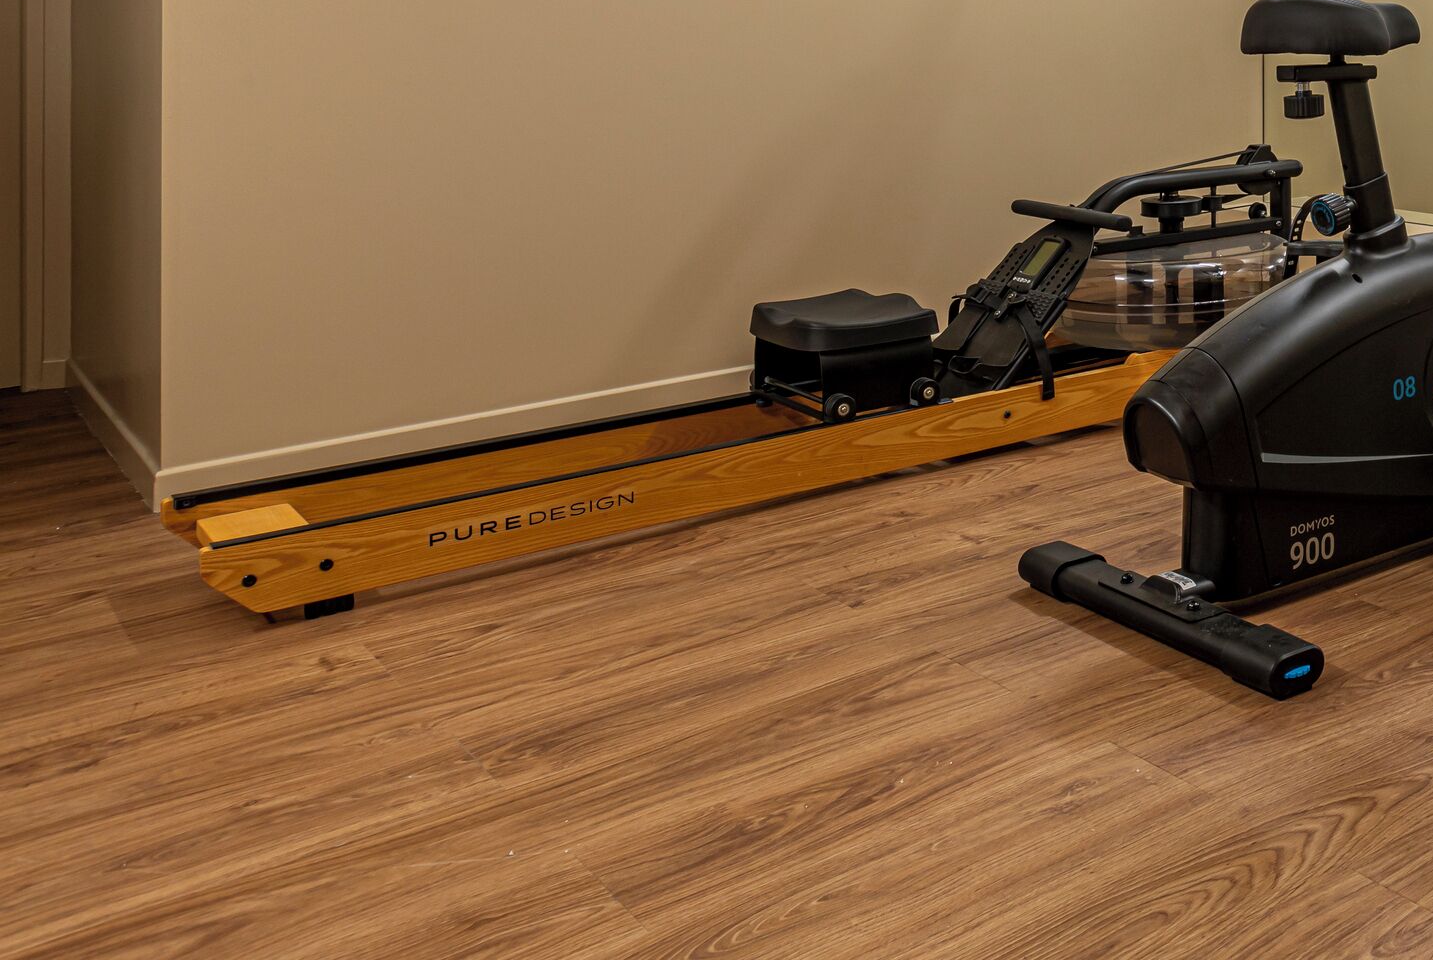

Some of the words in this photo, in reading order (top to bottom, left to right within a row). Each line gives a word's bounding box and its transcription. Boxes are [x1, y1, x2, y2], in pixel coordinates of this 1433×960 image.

[1392, 375, 1416, 401] 08
[1290, 514, 1335, 537] DOMYOS
[1290, 532, 1335, 570] 900
